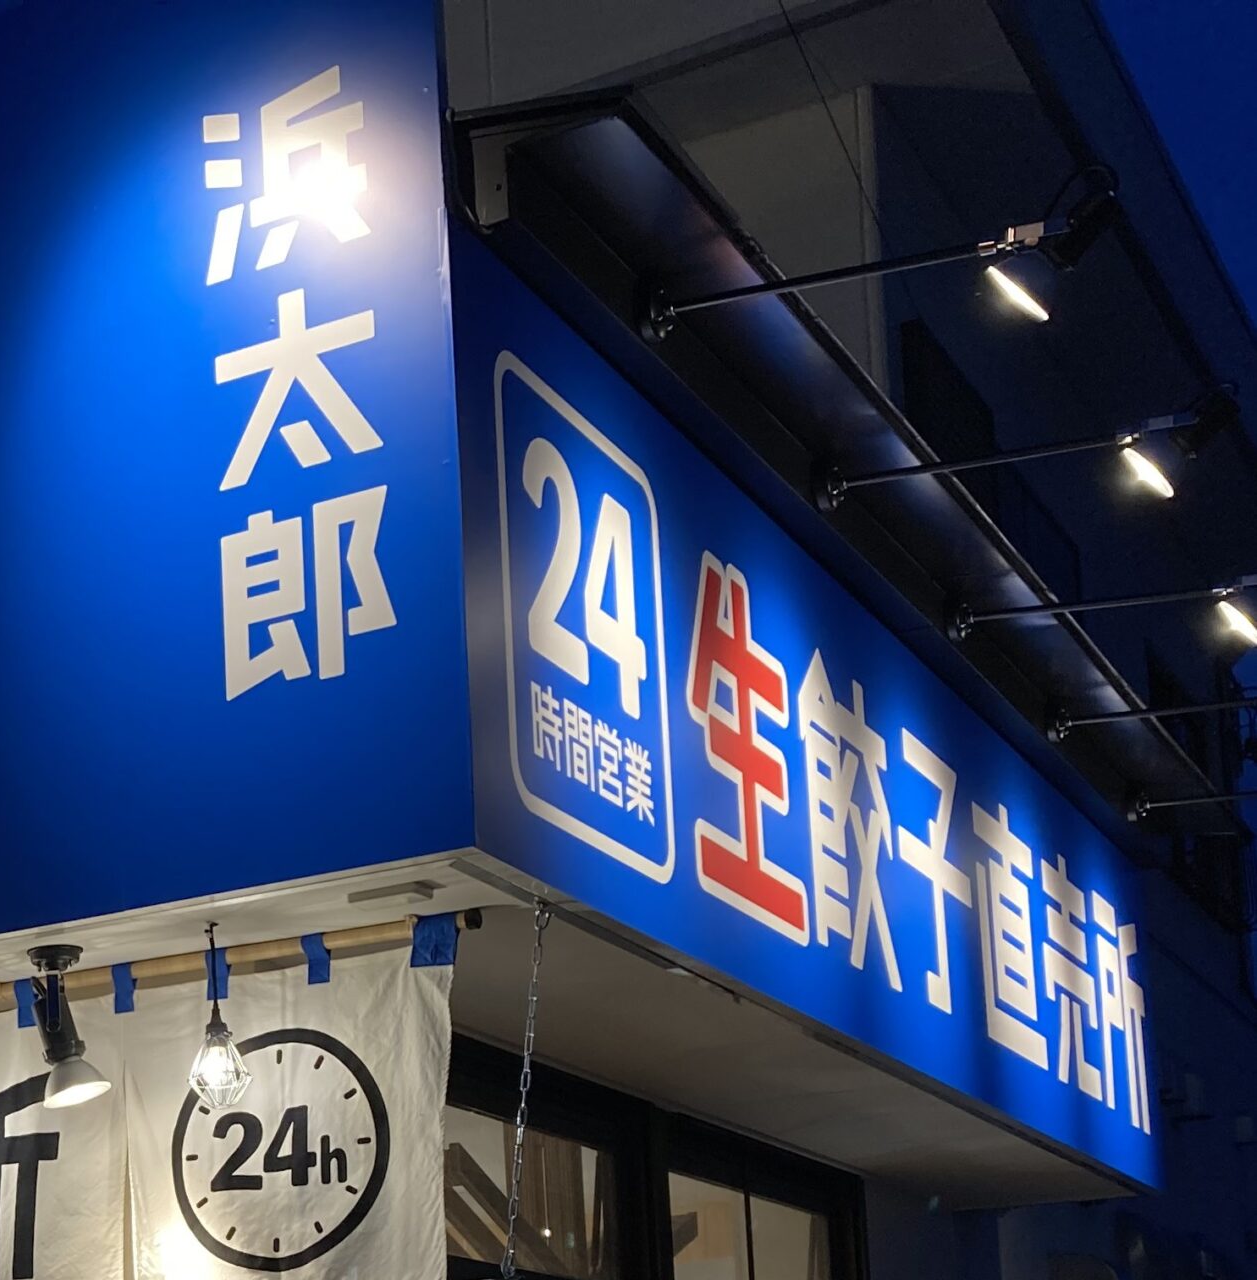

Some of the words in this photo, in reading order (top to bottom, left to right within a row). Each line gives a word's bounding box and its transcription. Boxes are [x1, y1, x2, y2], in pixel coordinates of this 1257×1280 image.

[202, 65, 397, 701] 浜太郎
[522, 437, 647, 719] 24
[529, 680, 655, 828] 時間営業
[686, 549, 1151, 1136] 生餃子直売所
[210, 1106, 347, 1192] 24h
